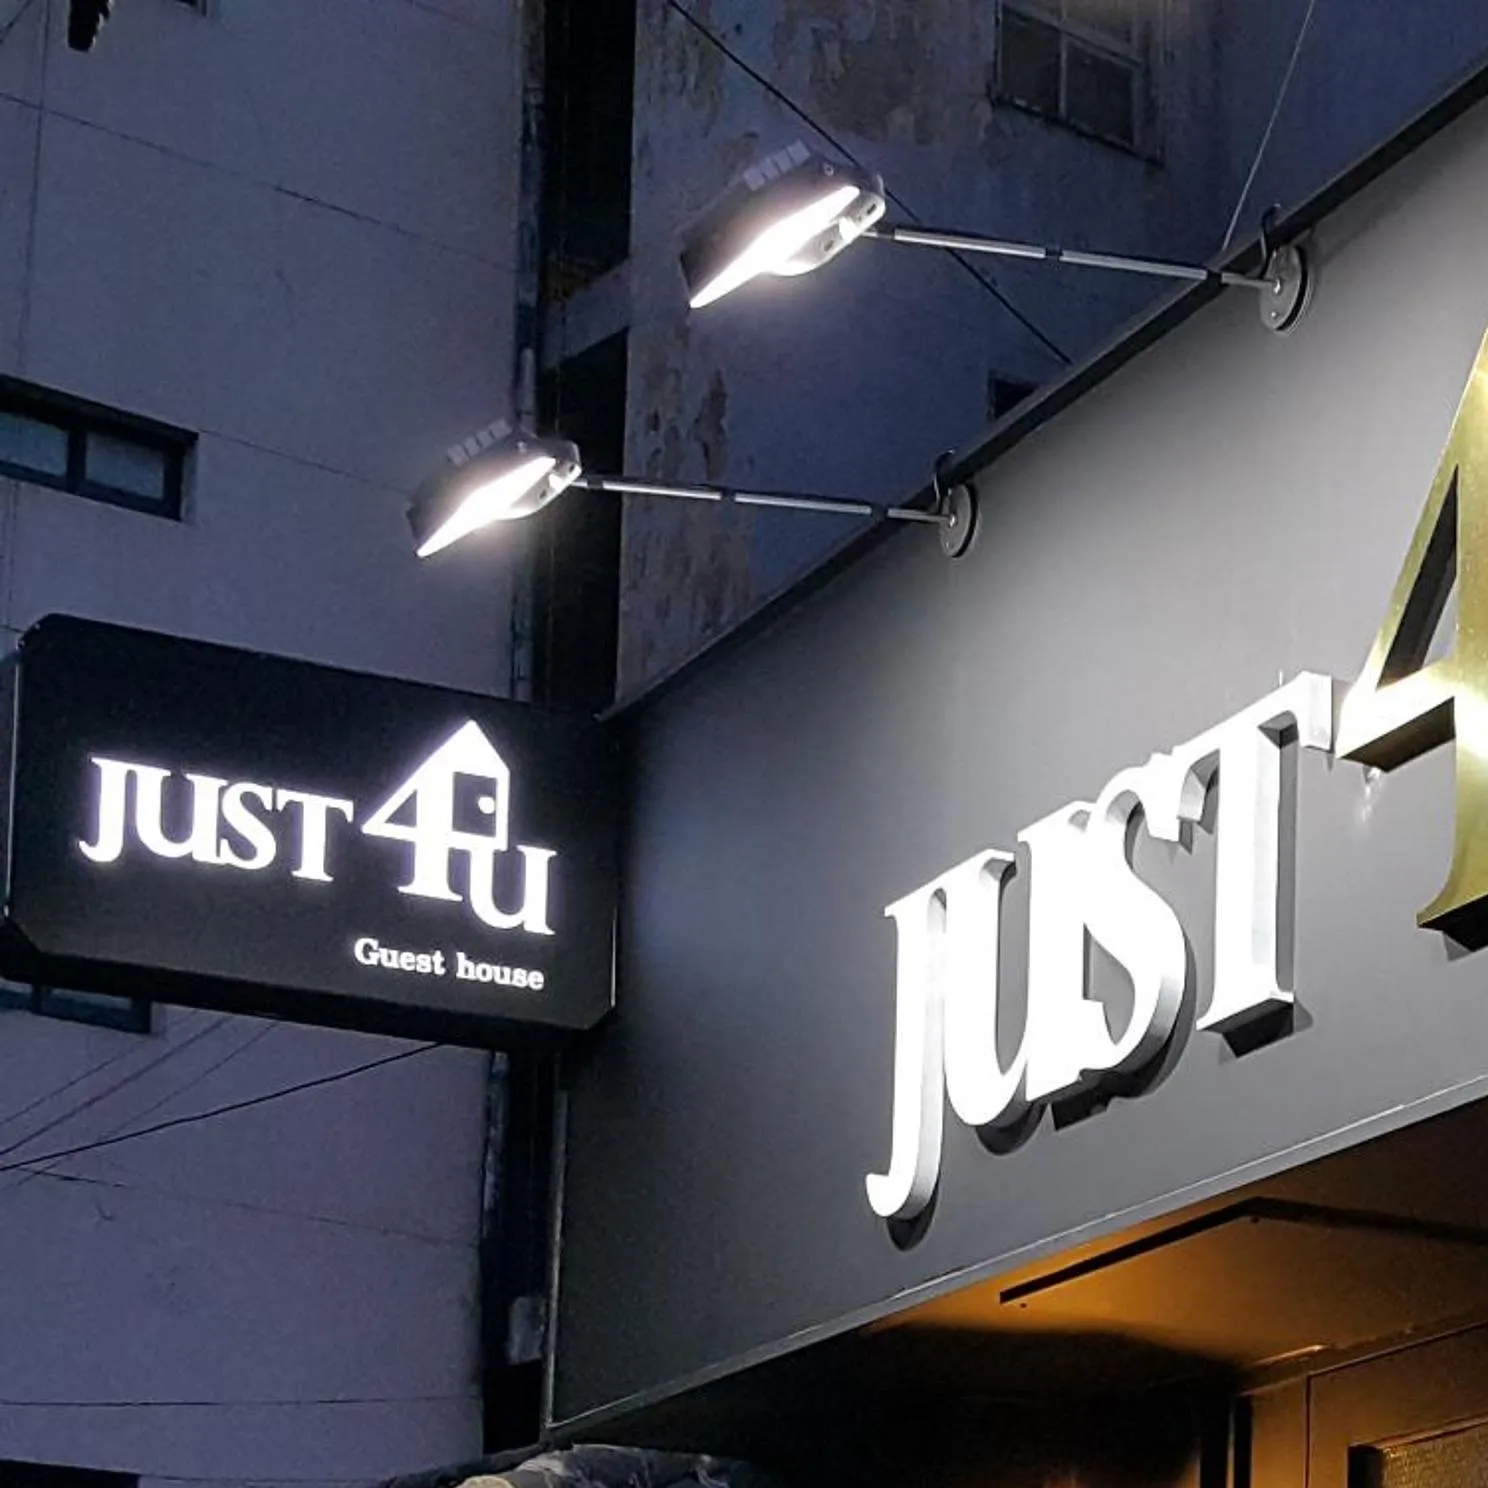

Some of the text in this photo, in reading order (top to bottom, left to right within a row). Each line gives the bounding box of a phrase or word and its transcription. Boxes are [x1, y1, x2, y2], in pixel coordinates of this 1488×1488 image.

[79, 757, 353, 881] JUST
[354, 937, 545, 990] Guest house
[865, 671, 1335, 1222] JUST
